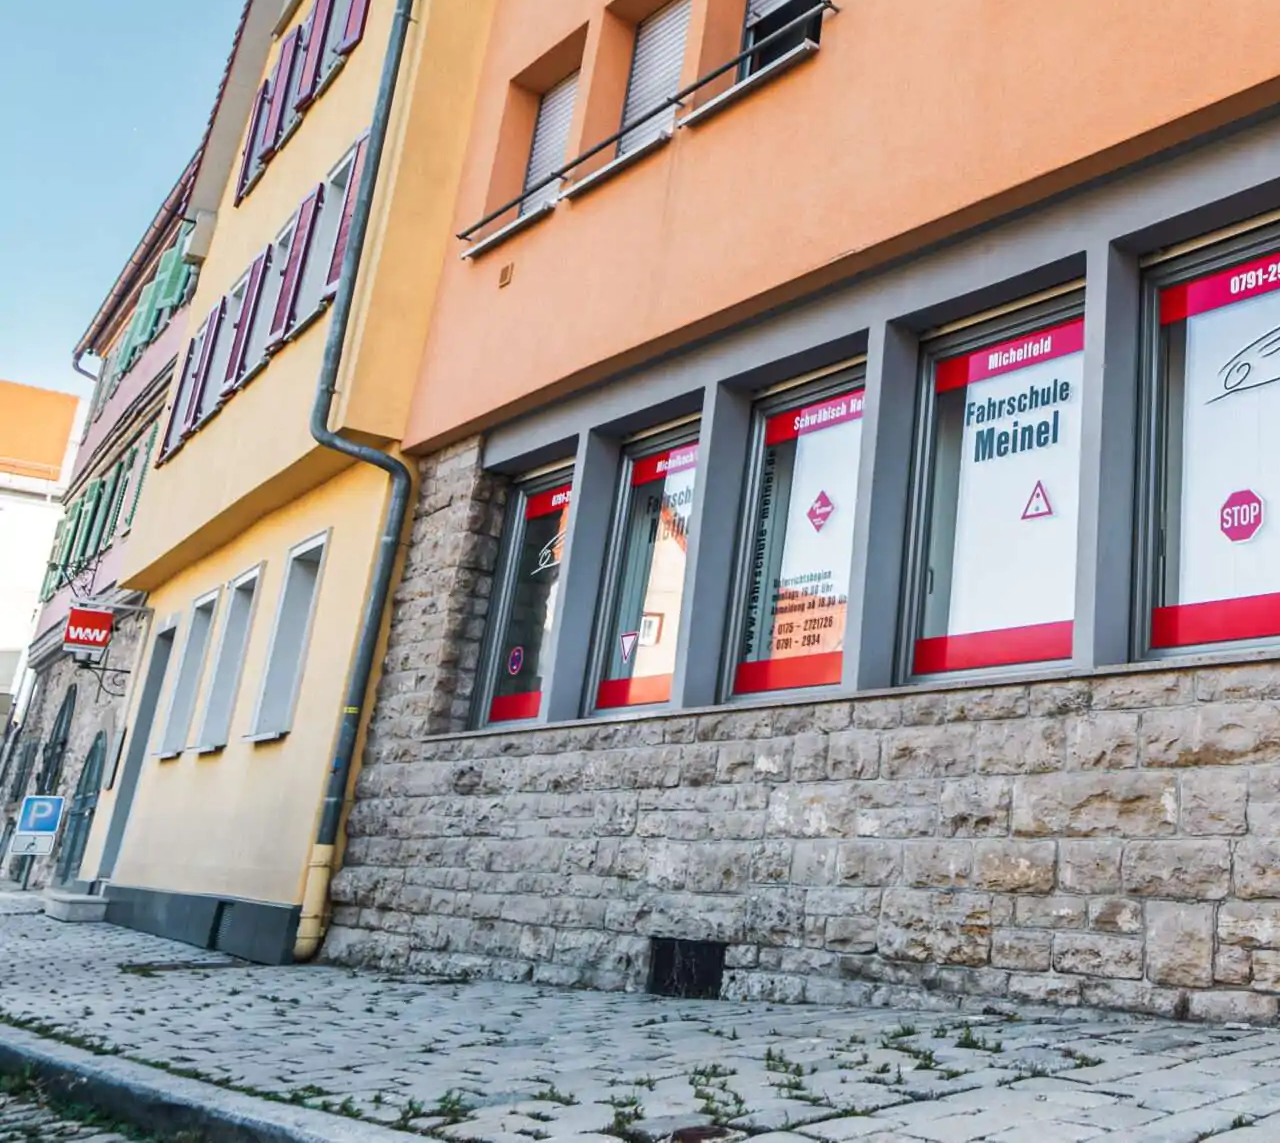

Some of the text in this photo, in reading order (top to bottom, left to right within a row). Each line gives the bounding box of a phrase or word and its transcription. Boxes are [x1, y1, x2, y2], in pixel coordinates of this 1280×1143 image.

[988, 335, 1051, 370] Michelfeld
[794, 395, 866, 431] Schwäbisch Hal
[966, 378, 1070, 426] Fahrschule
[974, 410, 1059, 463] Meinel
[647, 486, 692, 514] Fahrsch
[1223, 502, 1259, 528] STOP
[776, 637, 792, 650] 0791
[801, 634, 820, 646] 2934
[778, 622, 794, 635] 0175
[29, 801, 53, 828] P
